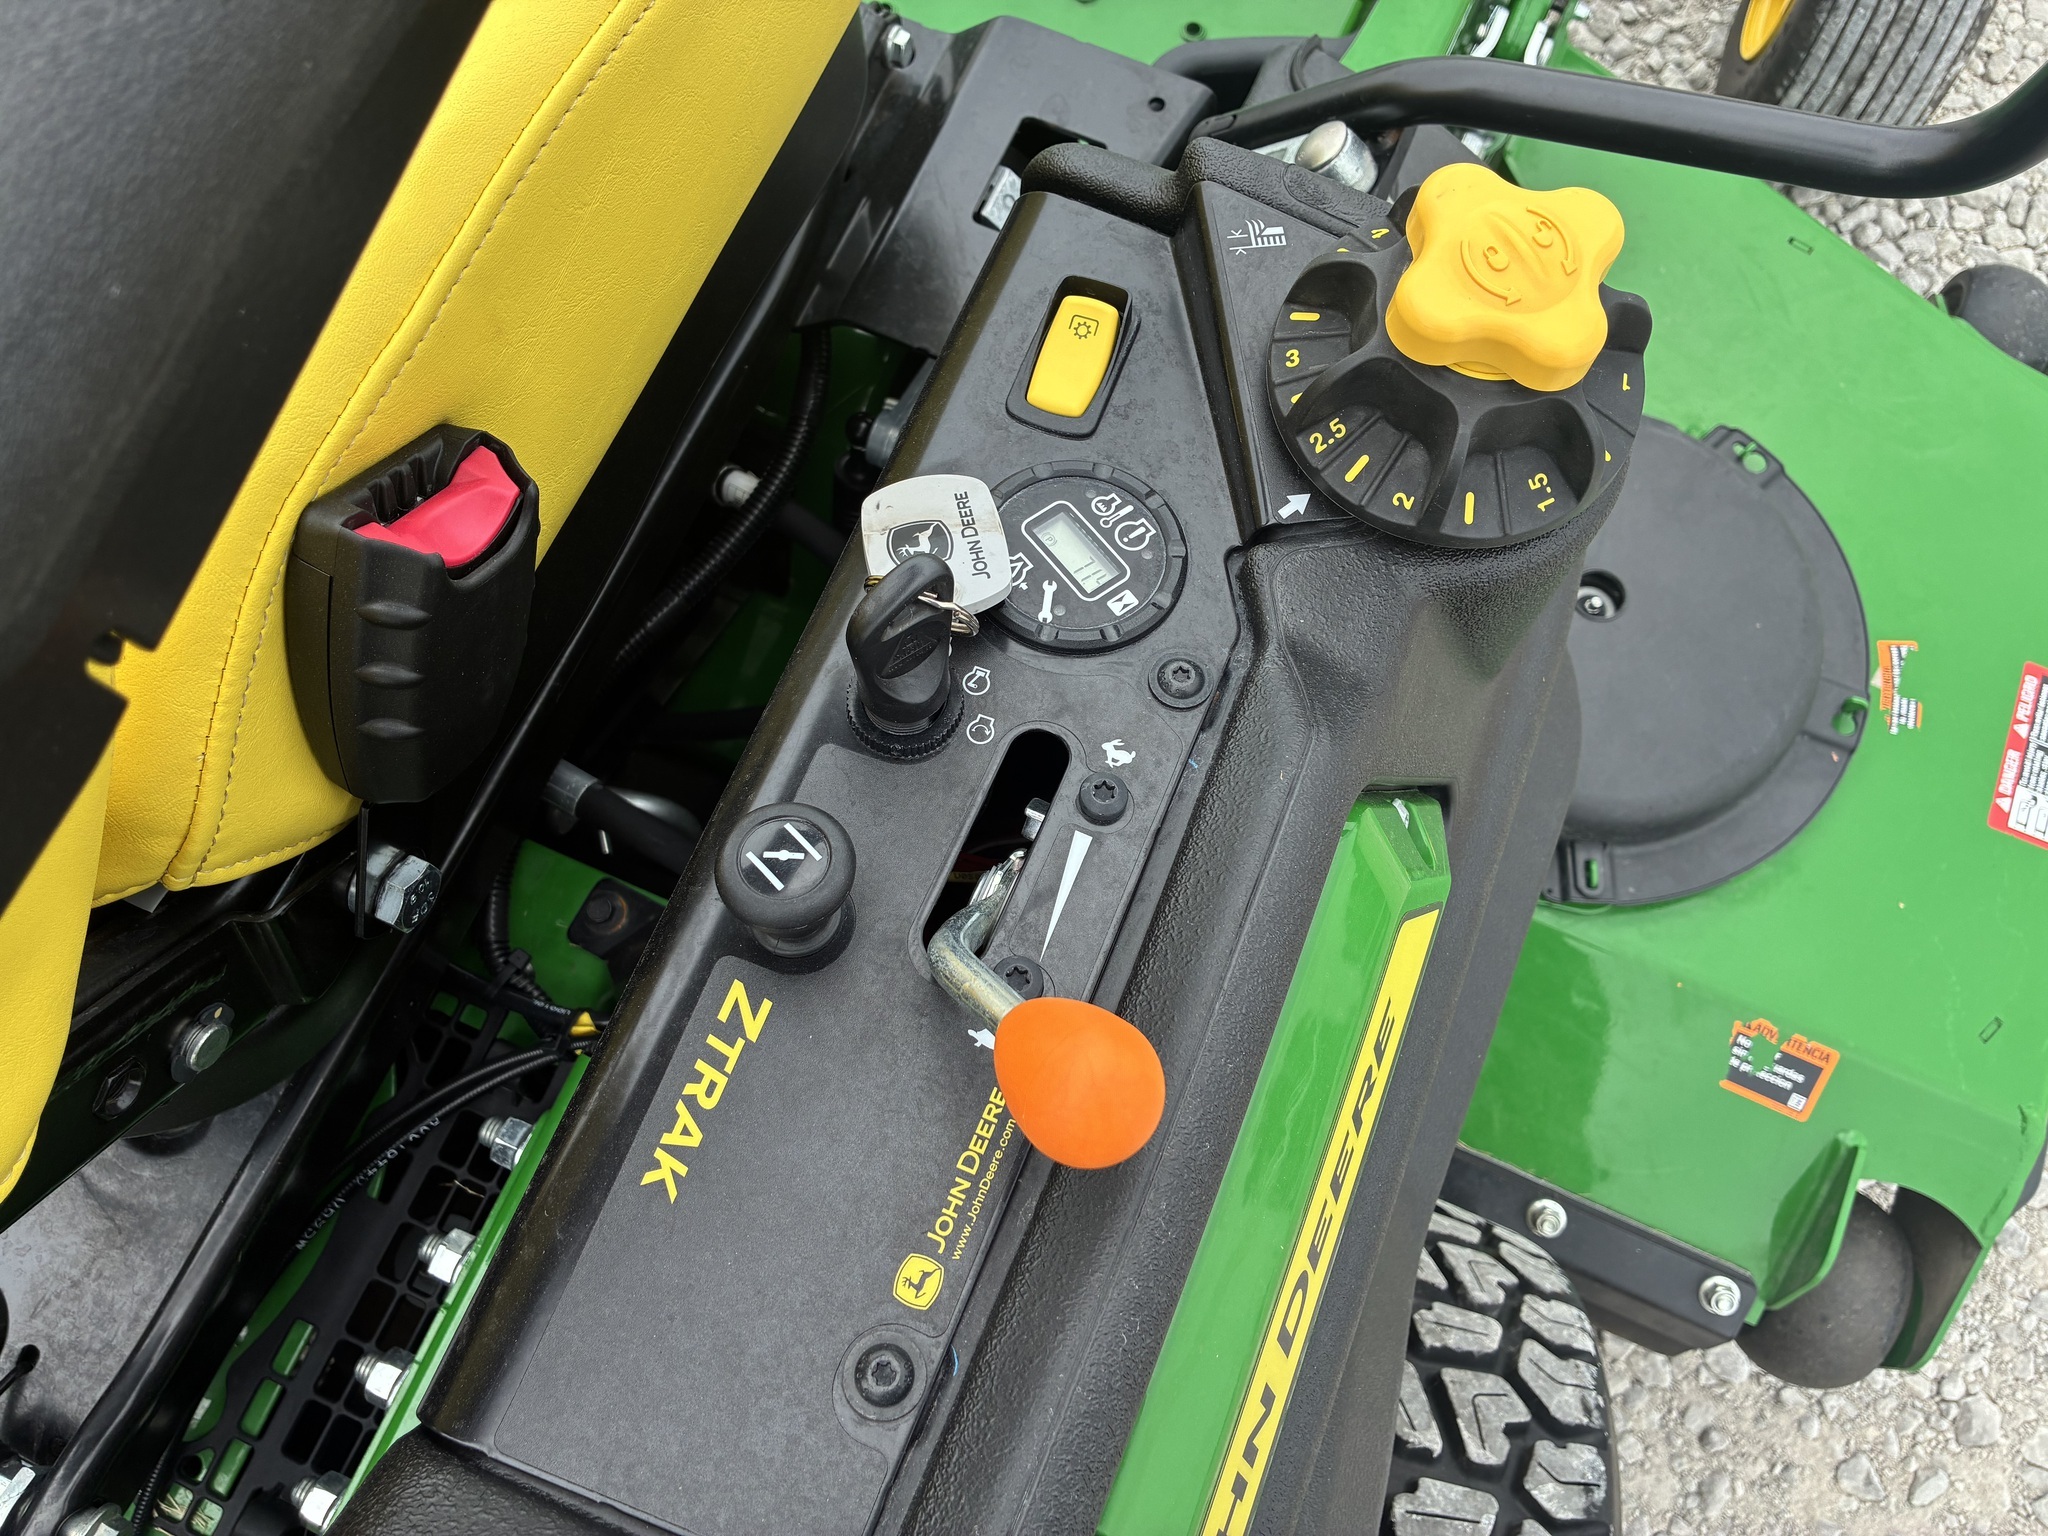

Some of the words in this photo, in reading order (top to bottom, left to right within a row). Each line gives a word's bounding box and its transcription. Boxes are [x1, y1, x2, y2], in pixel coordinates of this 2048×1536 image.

[1285, 349, 1300, 368] 3
[1622, 373, 1631, 391] 1
[1309, 417, 1347, 454] 2.5
[954, 490, 977, 538] DEERE
[1392, 492, 1415, 510] 2
[1528, 472, 1555, 512] 1.5
[965, 538, 991, 580] JOHN
[1998, 748, 2022, 797] DANGER
[639, 978, 773, 1204] ZTRAK
[926, 1177, 972, 1254] JOHN
[956, 1086, 1006, 1178] DEERE
[952, 1118, 1017, 1260] www.JohnDeere.com
[1276, 997, 1397, 1359] DEERE
